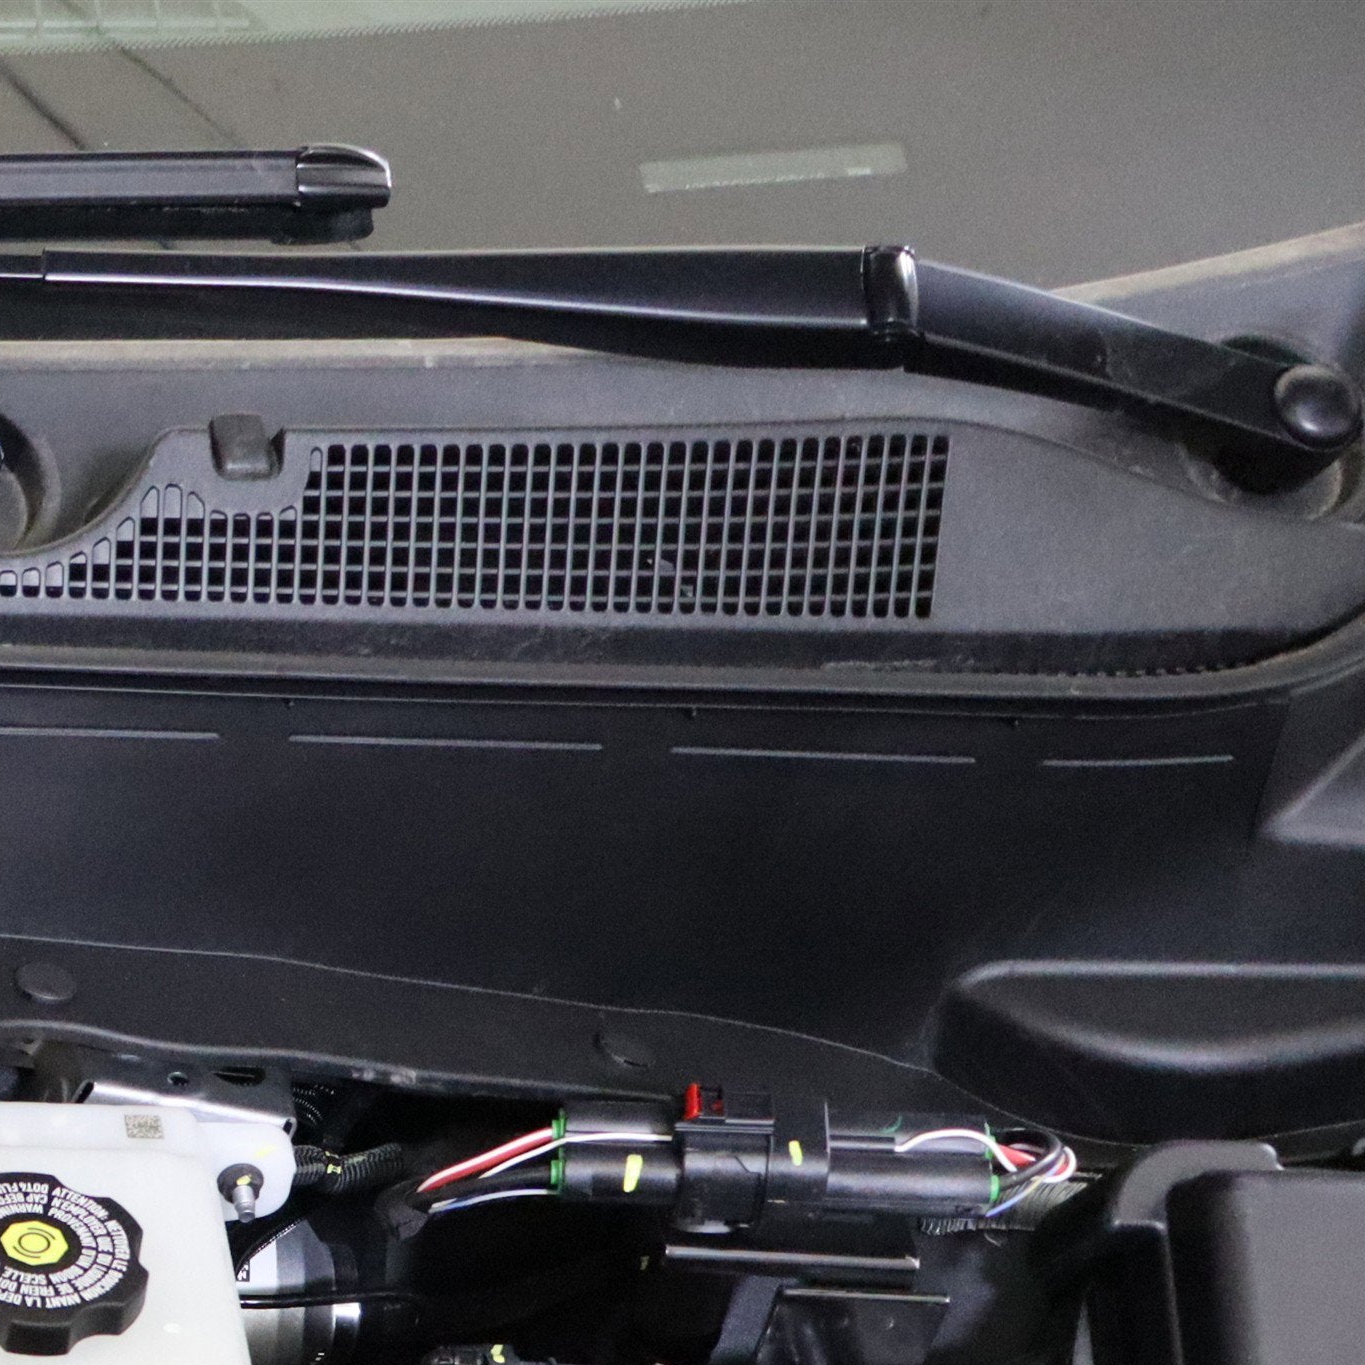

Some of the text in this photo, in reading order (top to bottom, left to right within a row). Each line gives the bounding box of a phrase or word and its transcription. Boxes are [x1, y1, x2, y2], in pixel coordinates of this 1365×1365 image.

[19, 1182, 48, 1193] DOT4
[26, 1194, 48, 1204] CAP
[20, 1284, 55, 1297] FREIN
[24, 1296, 42, 1308] LA
[45, 1293, 81, 1308] AVANT
